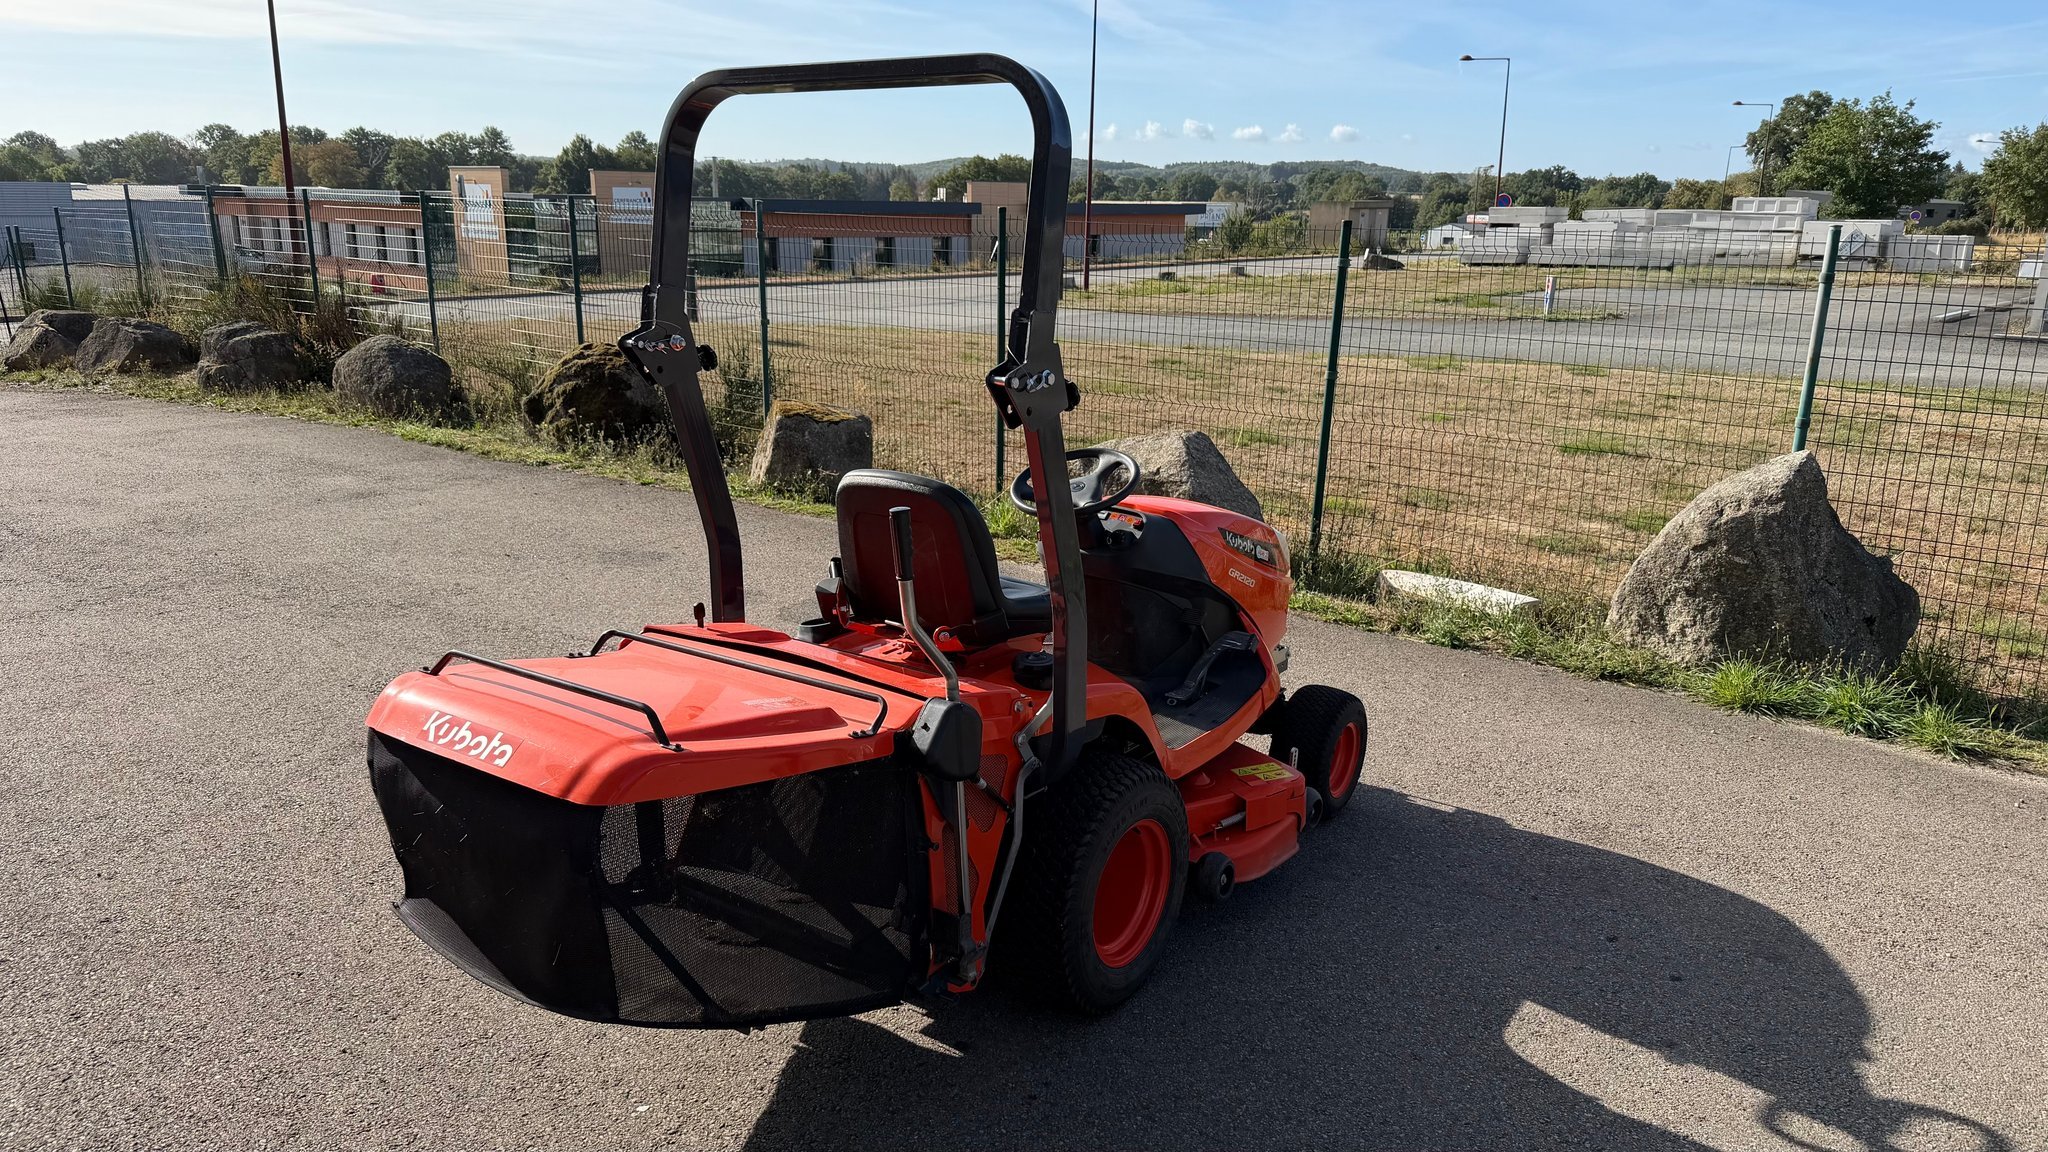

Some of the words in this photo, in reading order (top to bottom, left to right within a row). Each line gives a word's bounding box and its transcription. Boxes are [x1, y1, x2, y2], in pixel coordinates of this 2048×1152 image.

[1226, 531, 1255, 555] Kubota
[1228, 567, 1256, 588] GR2120
[422, 710, 513, 768] Kubota
